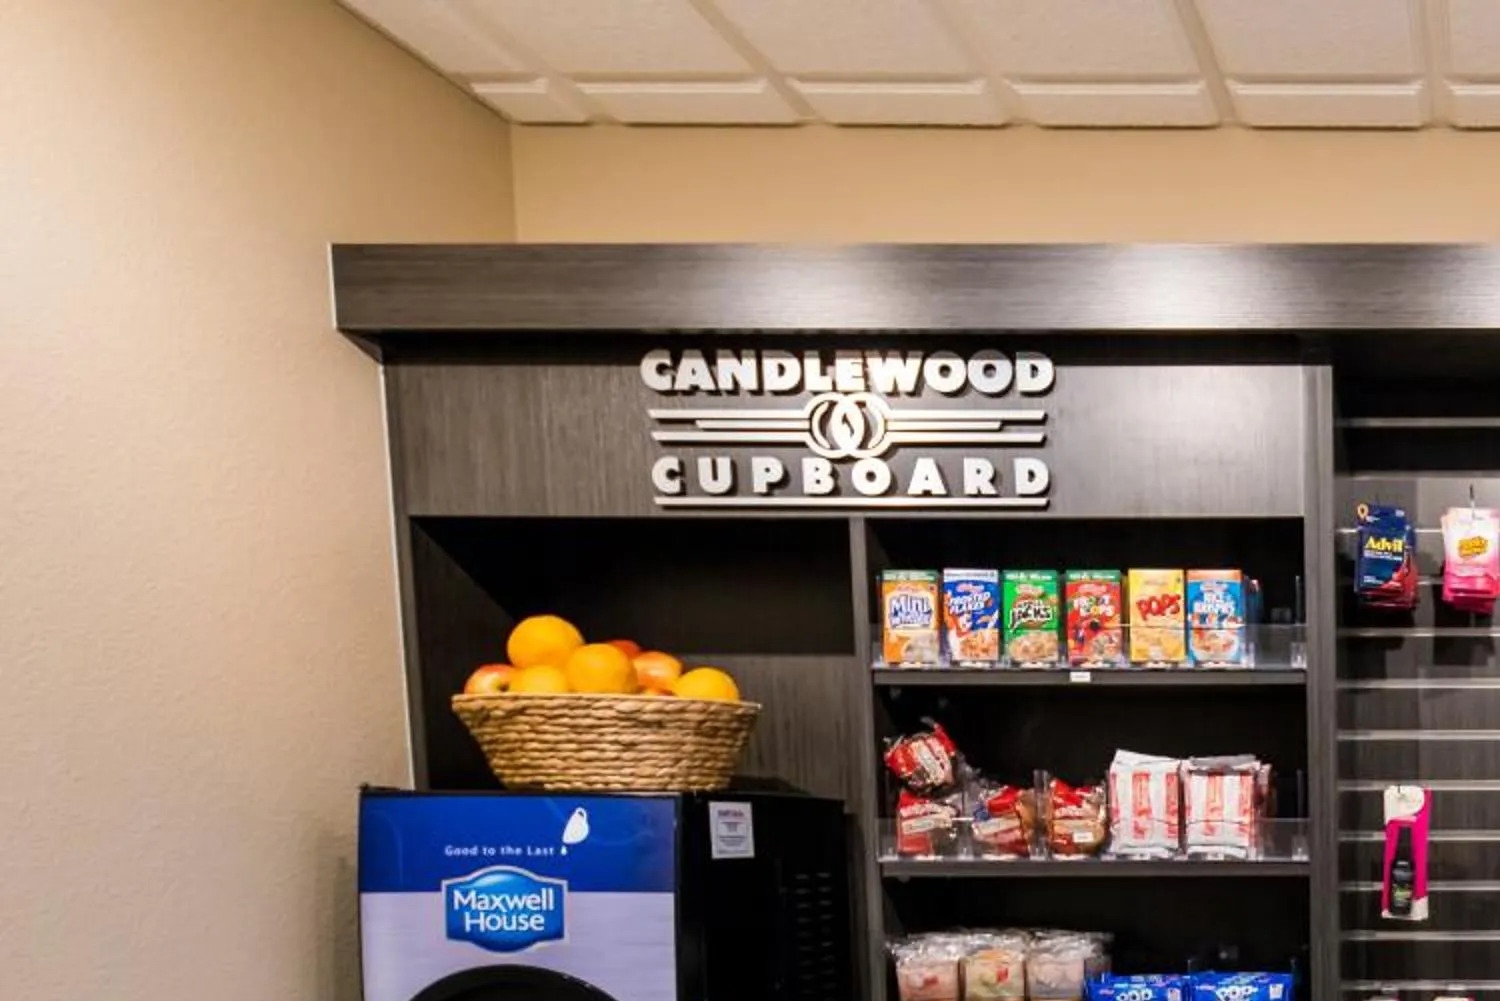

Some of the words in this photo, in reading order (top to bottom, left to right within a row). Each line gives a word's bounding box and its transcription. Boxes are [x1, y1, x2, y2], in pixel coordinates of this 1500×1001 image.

[640, 349, 1056, 394] CANDLEWOOD
[651, 456, 1051, 496] CUPBOARD
[1364, 535, 1406, 552] Advil
[1136, 593, 1182, 621] POPS
[444, 844, 478, 857] Good
[482, 845, 497, 857] to
[501, 845, 523, 857] the
[527, 845, 555, 857] Last
[452, 887, 554, 913] Maxwell
[465, 911, 545, 932] House
